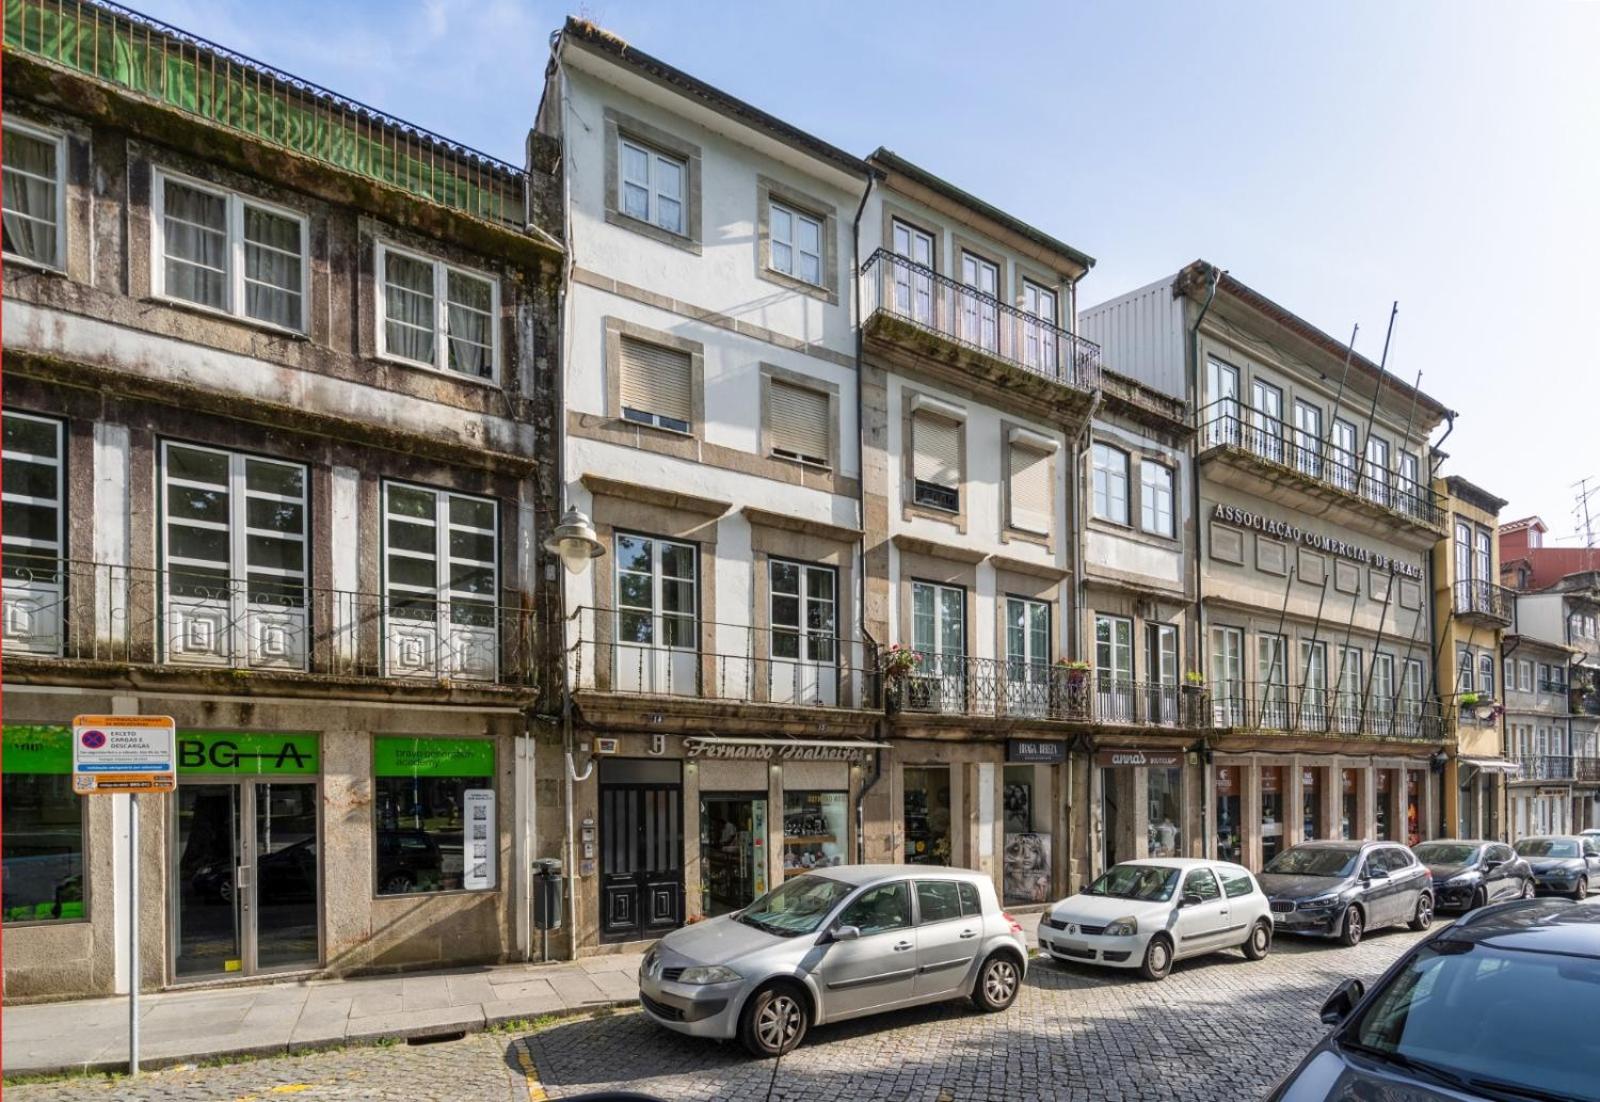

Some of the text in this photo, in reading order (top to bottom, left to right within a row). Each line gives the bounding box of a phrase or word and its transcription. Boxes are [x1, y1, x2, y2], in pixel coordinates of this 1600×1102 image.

[1305, 531, 1372, 562] COMERCIAL
[1376, 553, 1390, 569] DE
[1393, 559, 1424, 580] BRAGA
[683, 738, 773, 759] Fernando
